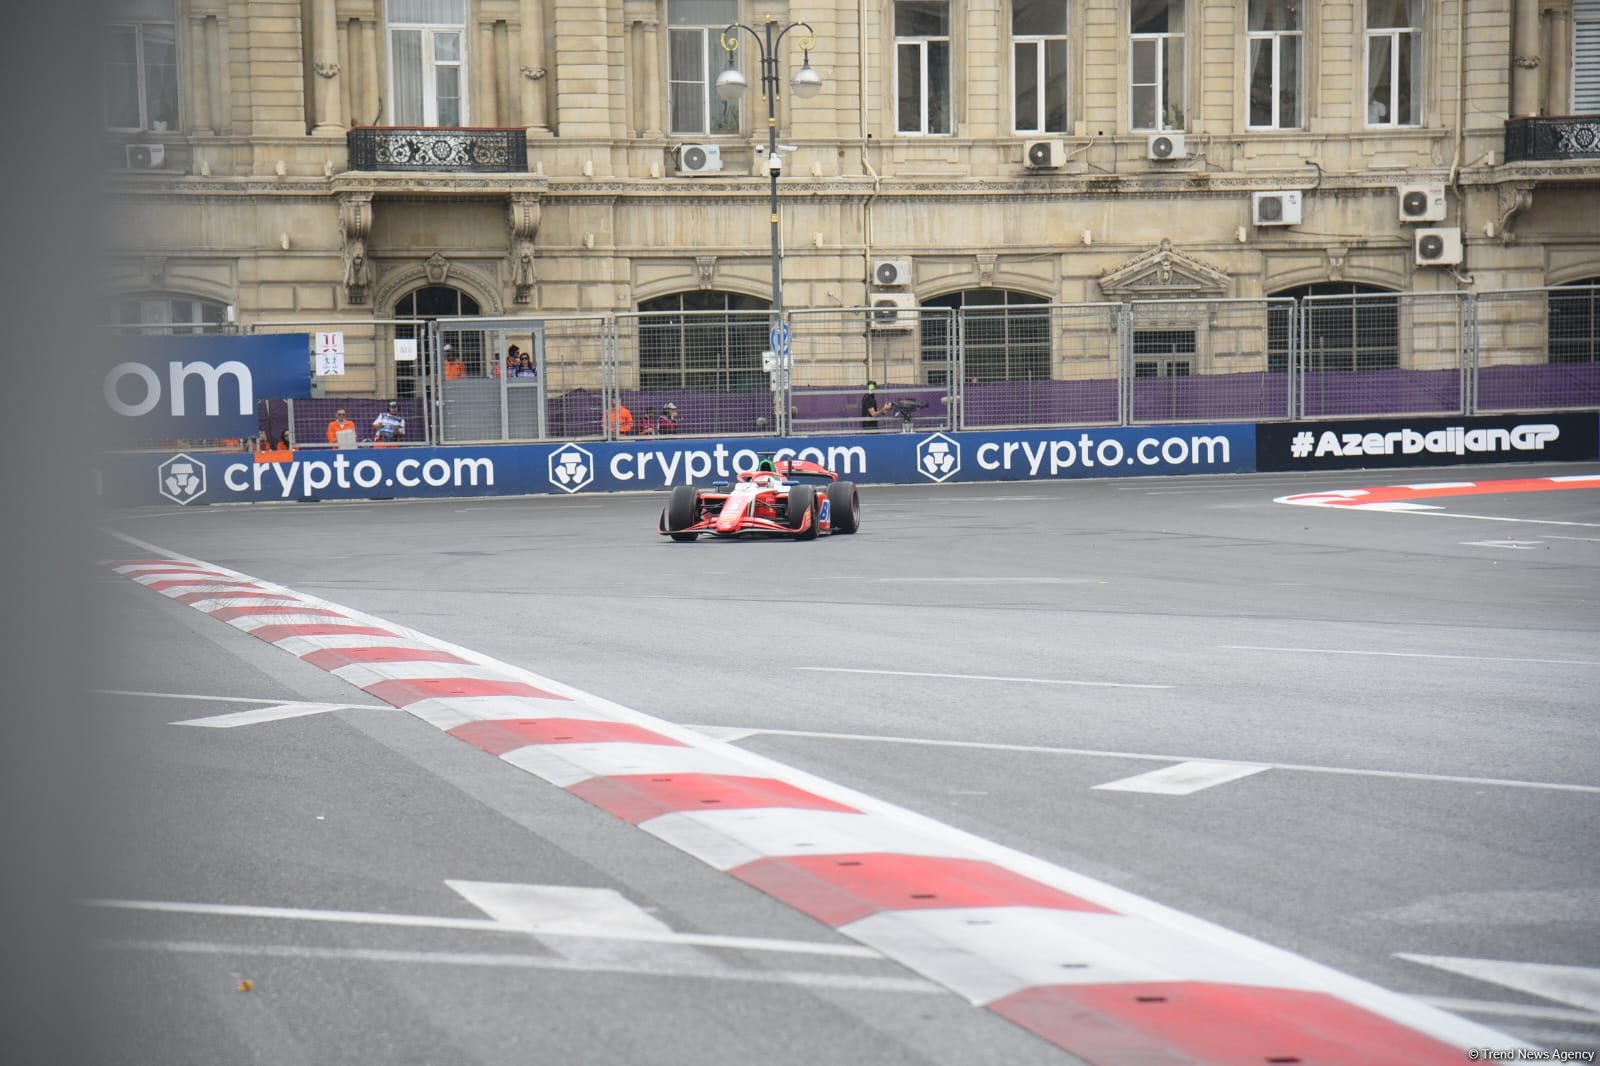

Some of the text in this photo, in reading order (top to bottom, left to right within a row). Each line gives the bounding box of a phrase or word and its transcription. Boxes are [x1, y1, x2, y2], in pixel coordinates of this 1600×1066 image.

[976, 433, 1231, 476] crypto.com
[1291, 424, 1560, 458] #AzerbaijanGP
[224, 454, 494, 498] crypto.com
[610, 443, 867, 487] cryptocom
